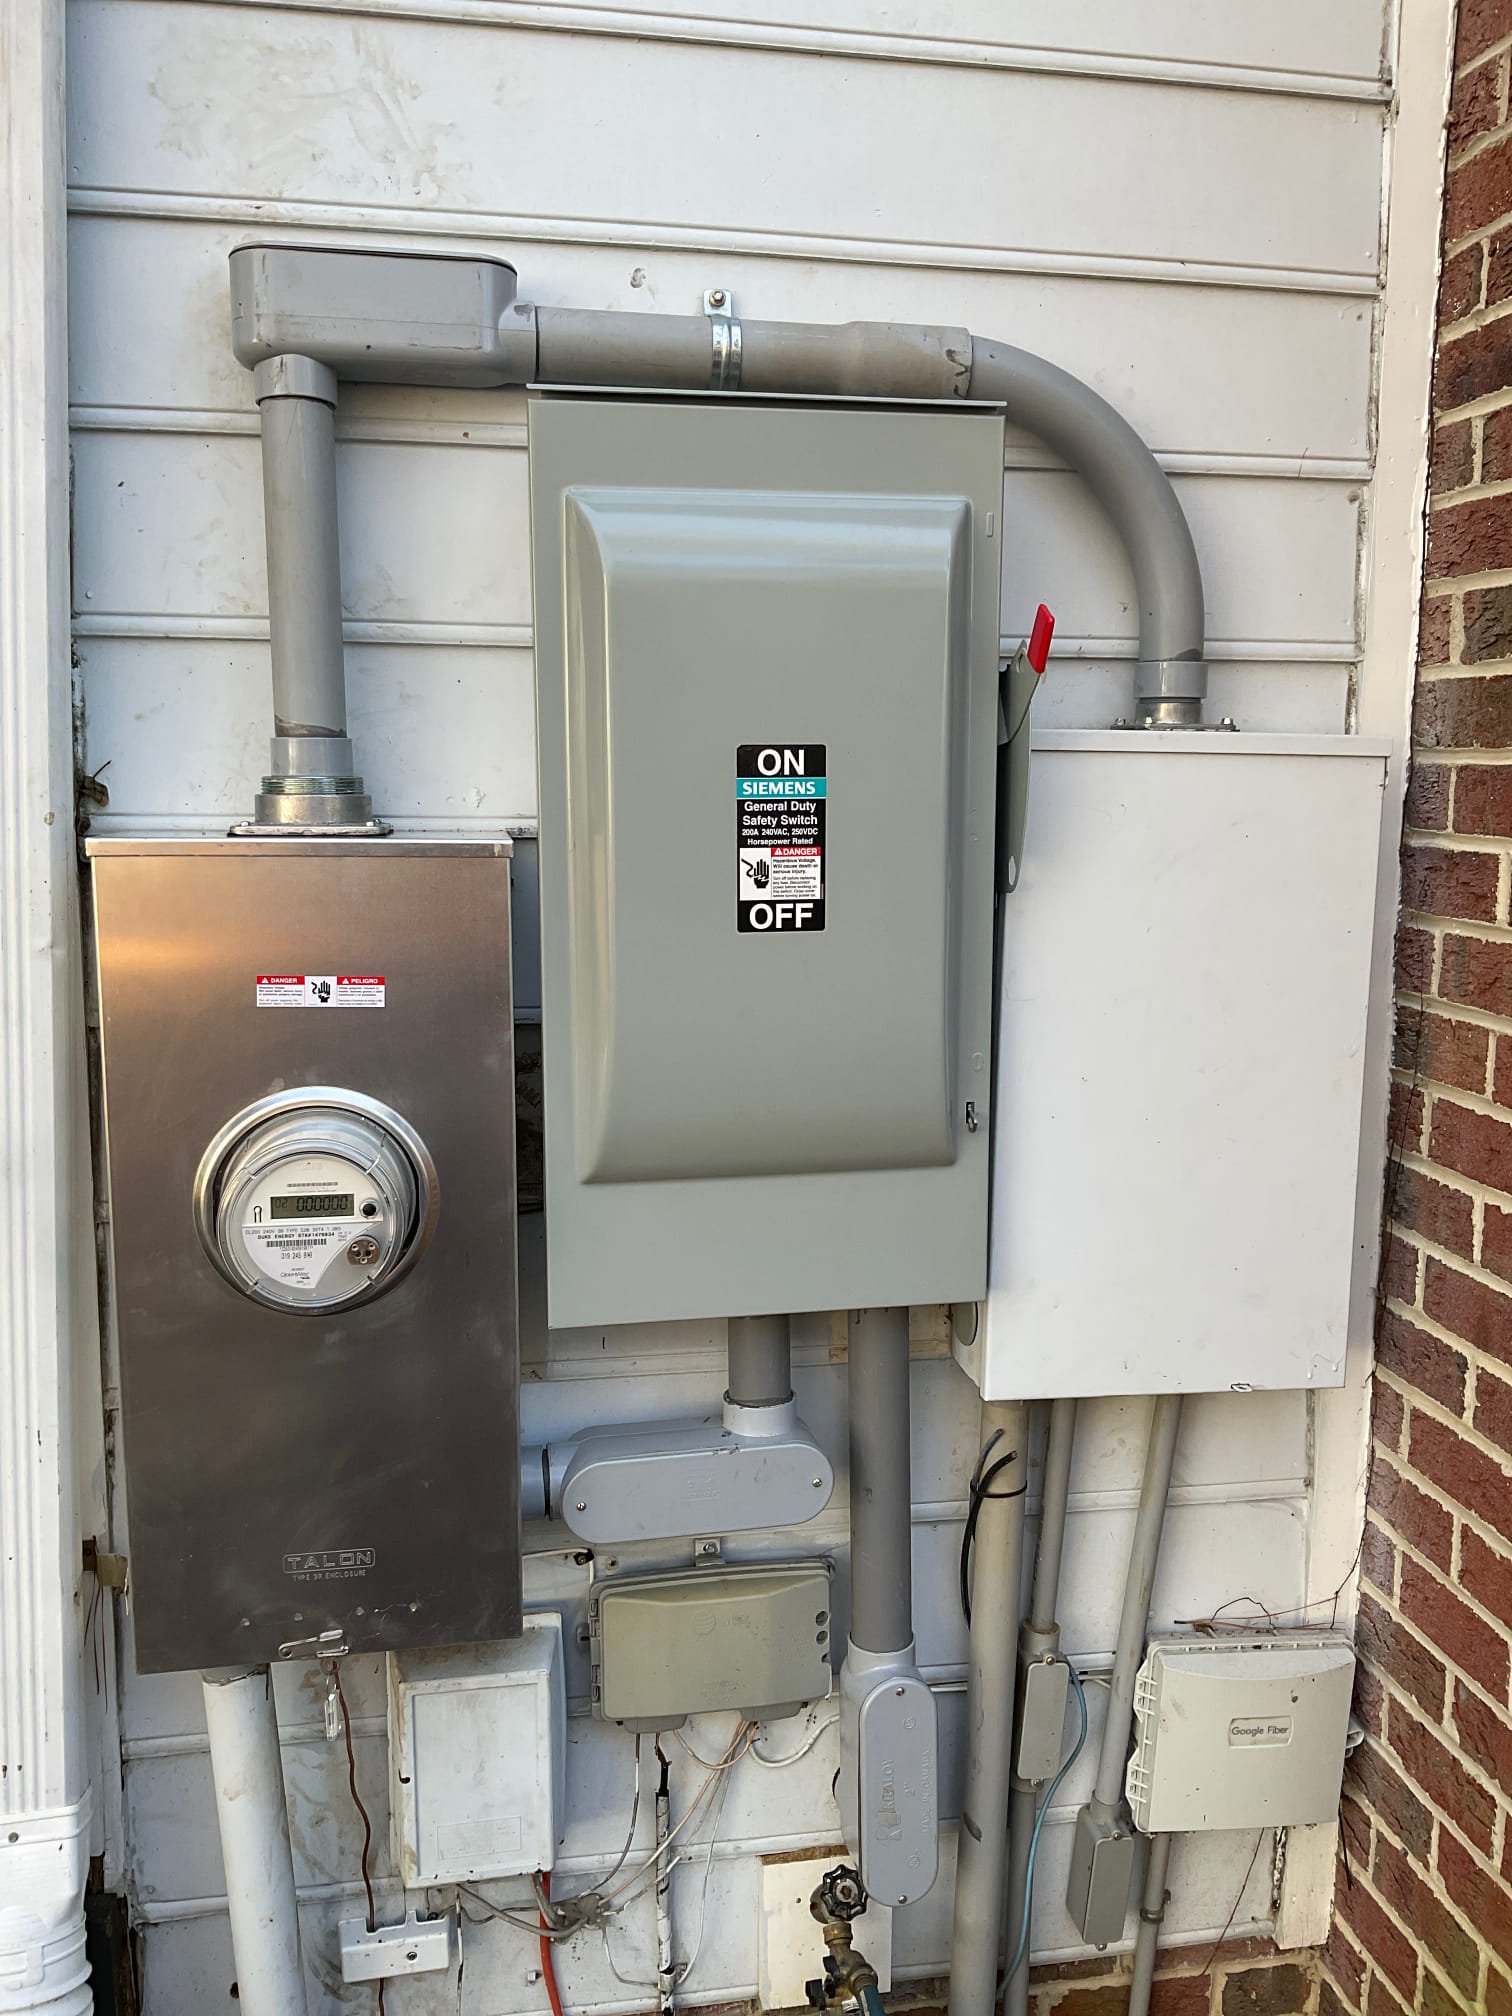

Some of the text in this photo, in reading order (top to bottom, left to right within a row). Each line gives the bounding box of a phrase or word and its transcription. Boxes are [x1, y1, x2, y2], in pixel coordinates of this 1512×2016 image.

[757, 749, 805, 776] ON
[743, 781, 816, 795] SIEMENS
[744, 801, 816, 813] General Duty
[742, 815, 818, 828] Safety Switch
[742, 828, 759, 836] 200A
[761, 828, 790, 836] 240VAC,
[747, 838, 790, 846] Horsepower
[749, 903, 814, 930] OFF
[296, 1196, 348, 1212] 000000
[287, 1552, 372, 1569] TALON
[325, 1570, 366, 1580] ENCLOSURE
[1231, 1725, 1289, 1737] Google Fiber
